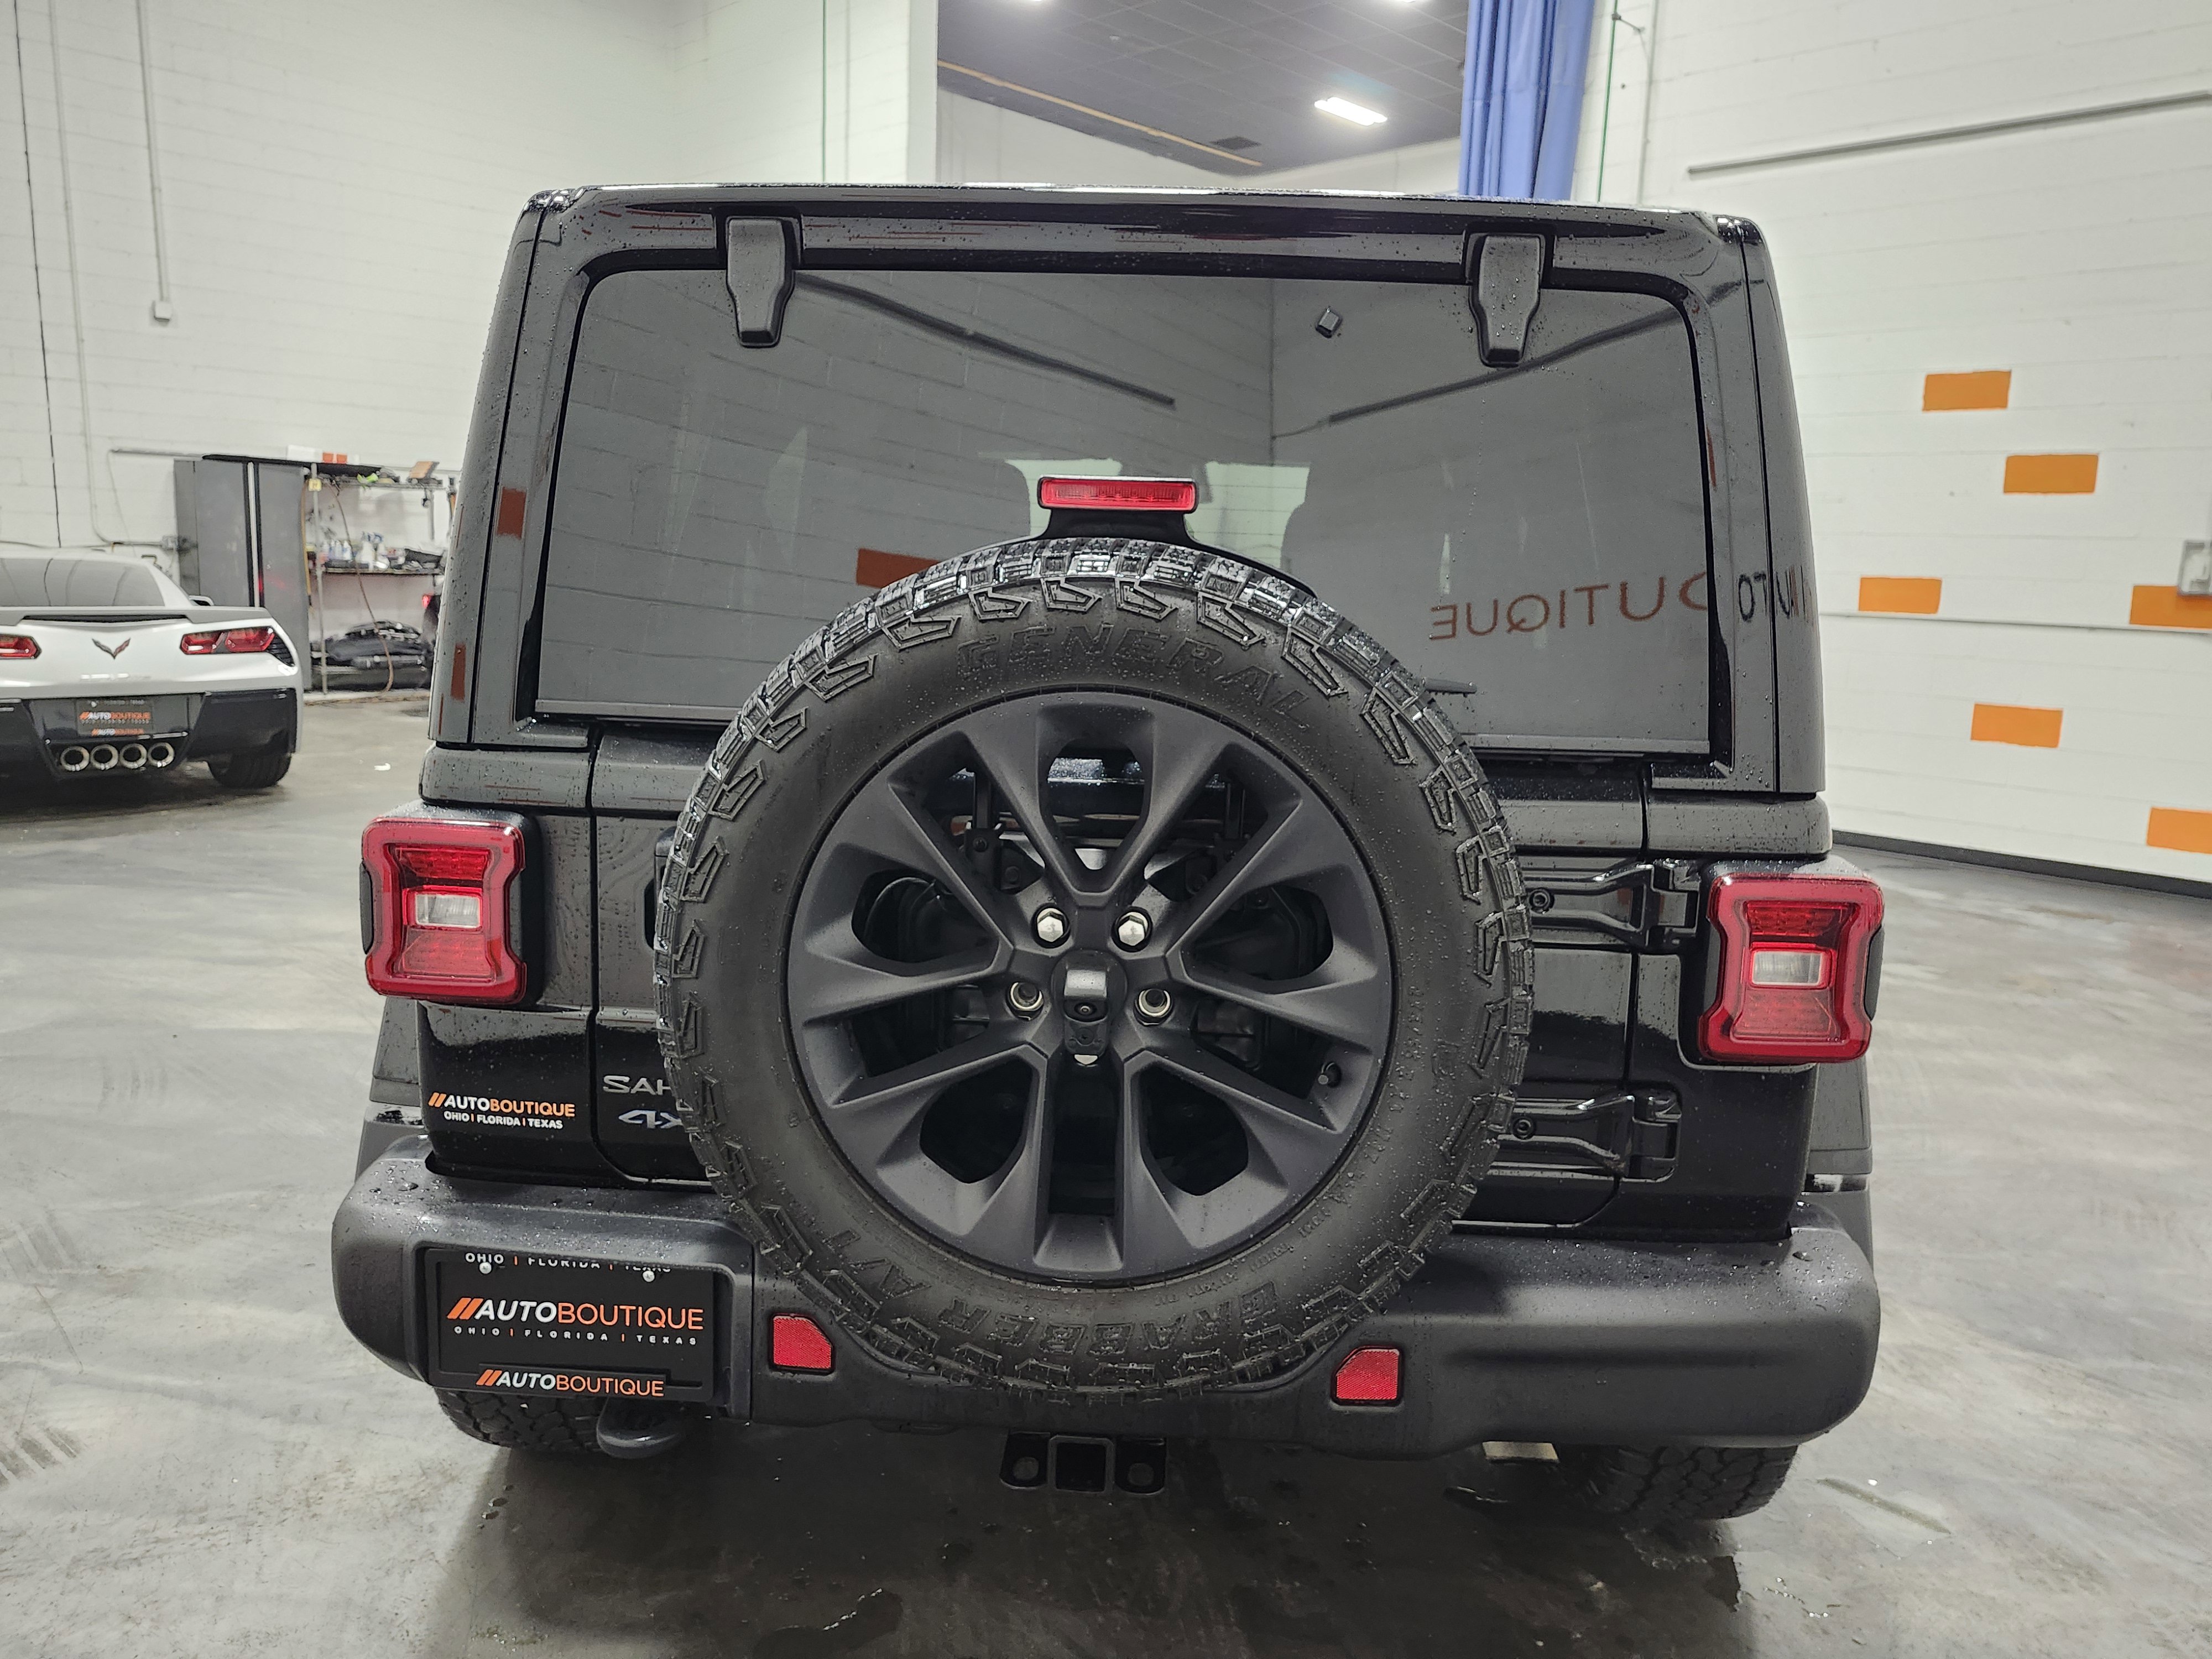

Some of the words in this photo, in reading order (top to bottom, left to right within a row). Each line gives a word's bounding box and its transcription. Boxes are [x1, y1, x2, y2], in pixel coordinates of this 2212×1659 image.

[957, 624, 1310, 731] GENERAL
[603, 1075, 671, 1095] SAH
[444, 1095, 576, 1117] AUTOBOUTIQUE
[444, 1111, 470, 1122] OHIO
[476, 1114, 521, 1126] FLORIDA
[527, 1118, 564, 1129] TEXAS
[465, 1253, 504, 1264] OHIO
[474, 1299, 704, 1330] AUTOBOUTIQUE
[938, 1281, 1279, 1355] GRABBER
[453, 1326, 500, 1336] OHIO
[524, 1329, 608, 1342] FLORIDA
[636, 1334, 696, 1345] TEXAS
[495, 1371, 665, 1397] AUTOBOUTIQUE
